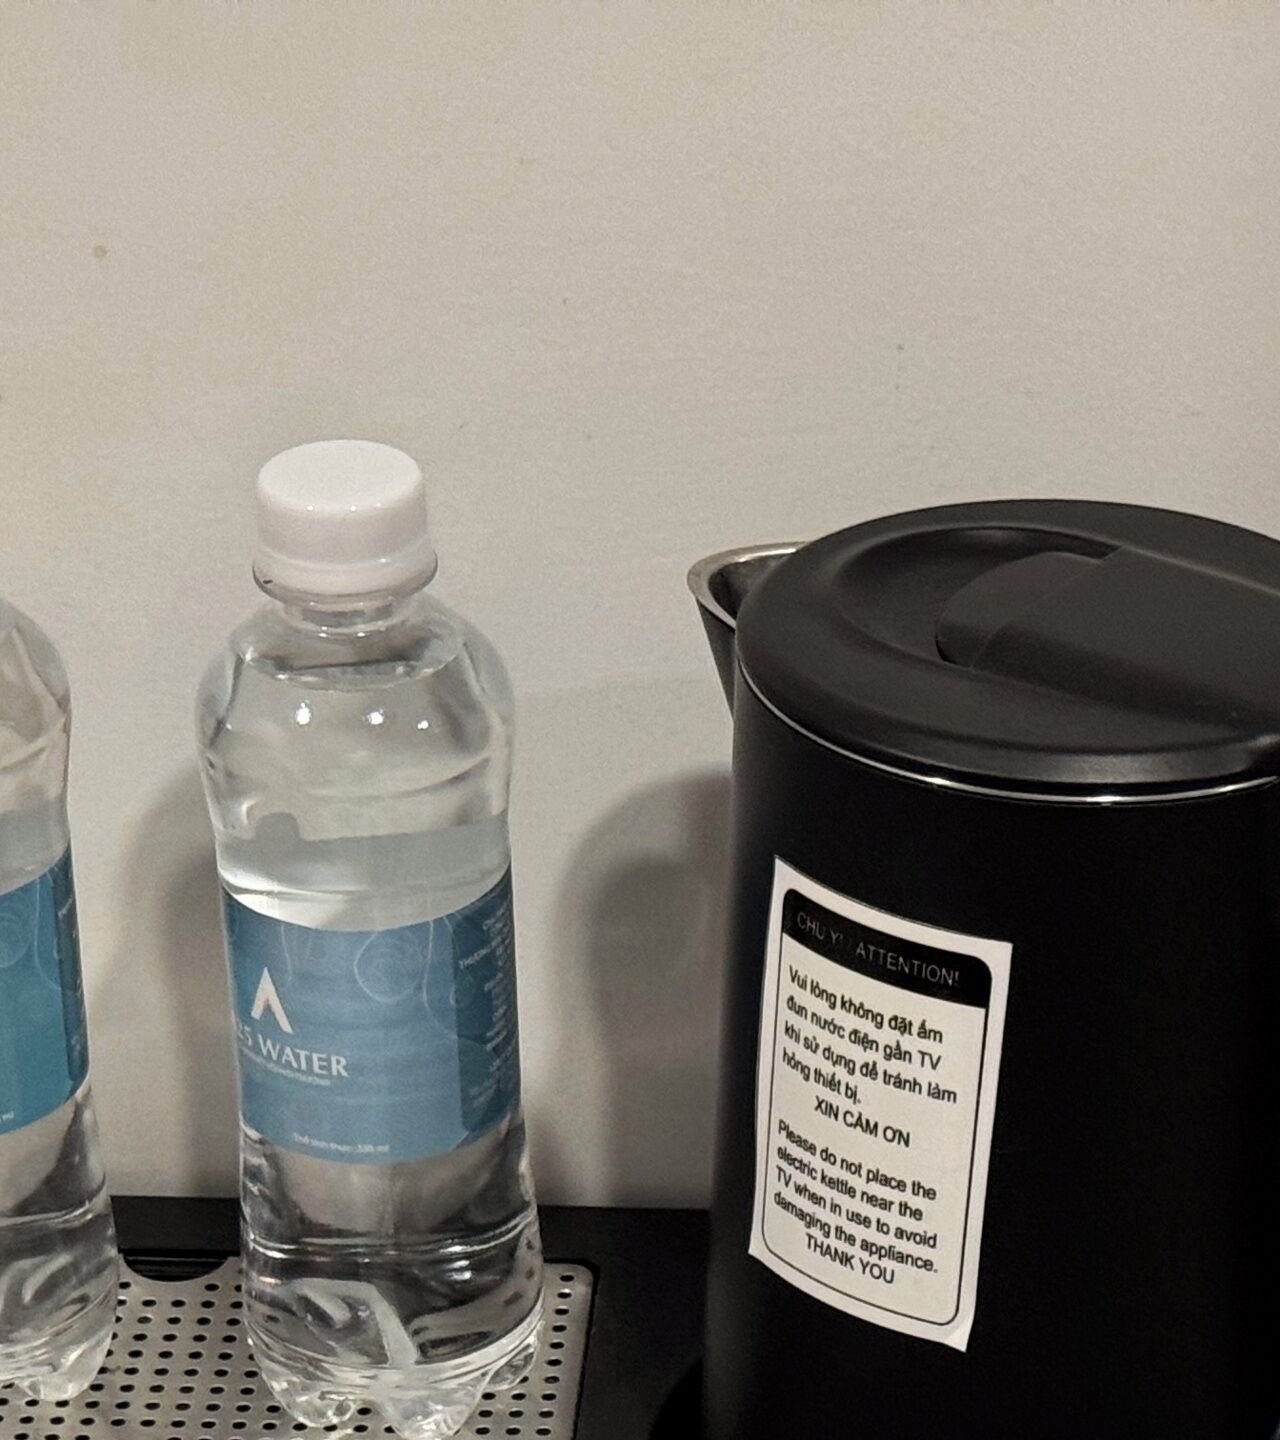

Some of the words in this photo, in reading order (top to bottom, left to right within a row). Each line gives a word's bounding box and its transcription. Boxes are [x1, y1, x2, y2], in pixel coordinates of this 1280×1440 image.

[854, 941, 960, 987] ATTENTION!
[786, 994, 808, 1021] đun
[811, 1010, 846, 1040] nước
[848, 1028, 879, 1053] điện
[883, 1039, 913, 1065] gần
[918, 1049, 942, 1071] TV
[789, 963, 808, 992] Vui
[810, 978, 838, 1011] lòng
[841, 993, 885, 1030] không
[888, 1014, 914, 1037] đặt
[917, 1018, 943, 1044] ấm
[258, 1033, 350, 1077] WATER
[782, 1046, 811, 1083] hỏng
[813, 1066, 842, 1096] thiết
[844, 1081, 862, 1106] bị.
[784, 1019, 801, 1045] khi
[803, 1035, 820, 1055] sử
[822, 1043, 856, 1077] dụng
[860, 1060, 879, 1082] để
[883, 1068, 923, 1096] tránh
[927, 1081, 958, 1105] làm
[814, 1094, 840, 1122] XIN
[843, 1110, 879, 1138] CẢM
[883, 1126, 911, 1148] ƠN
[777, 1146, 818, 1181] electric
[820, 1168, 857, 1199] kettle
[860, 1189, 895, 1213] near
[898, 1200, 923, 1222] the
[778, 1118, 817, 1157] Please
[820, 1146, 837, 1167] do
[840, 1157, 863, 1179] not
[866, 1167, 907, 1193] place
[911, 1180, 937, 1201] the
[773, 1191, 832, 1239] damaging
[834, 1224, 857, 1247] the
[859, 1238, 938, 1274] appliance.
[776, 1164, 792, 1188] TV
[793, 1180, 827, 1210] when
[830, 1196, 842, 1217] in
[845, 1208, 872, 1229] use
[876, 1217, 891, 1236] to
[894, 1226, 938, 1250] avoid
[805, 1232, 856, 1271] THANK
[858, 1257, 895, 1285] YOU
